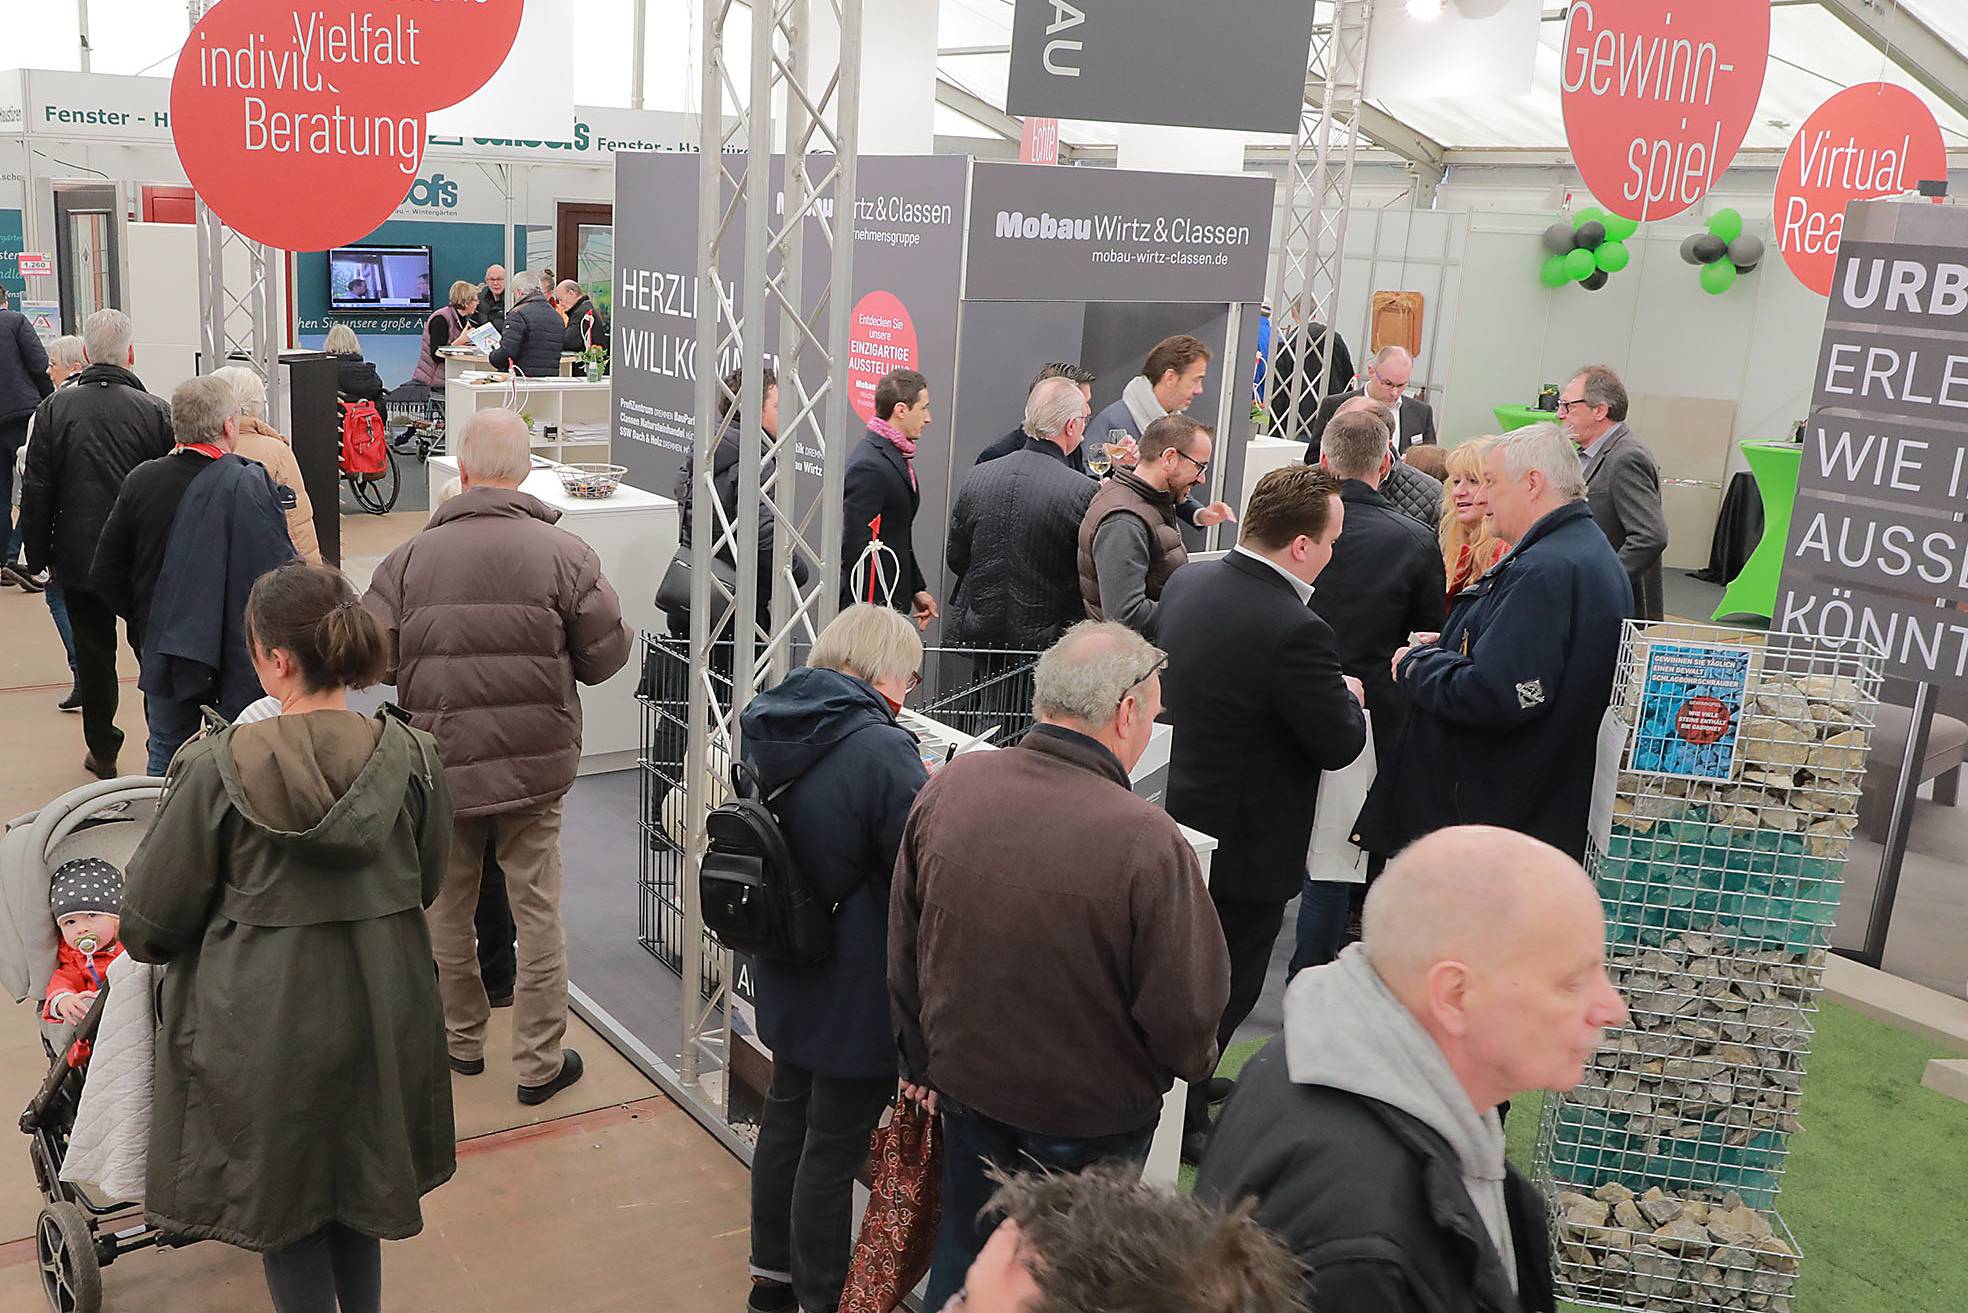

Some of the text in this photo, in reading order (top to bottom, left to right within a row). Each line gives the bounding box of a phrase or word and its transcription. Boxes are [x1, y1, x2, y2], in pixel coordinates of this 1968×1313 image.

[293, 11, 420, 66] Vielfalt
[1562, 0, 1734, 105] Gewinn-
[45, 106, 130, 125] Fenster
[245, 97, 418, 174] Beratung
[1623, 117, 1721, 222] spiel
[1800, 129, 1911, 191] Virtual
[889, 197, 951, 225] Classen
[1171, 218, 1249, 245] Classen
[1091, 250, 1228, 265] mobau-wirtz-classen.de
[381, 318, 411, 332] große
[859, 313, 904, 330] Entdecken Sie
[869, 330, 891, 341] unsere
[851, 340, 909, 362] EINZIGARTIGE
[620, 397, 654, 415] ProfiZentrum
[620, 412, 640, 426] Classen
[640, 416, 685, 438] Natursteinhandel
[619, 426, 632, 438] SSW
[632, 429, 645, 442] Dach
[650, 434, 662, 447] Holz
[804, 461, 823, 477] Wirtz
[1818, 428, 1929, 492] WIE
[1654, 655, 1693, 666] GEWINNEN
[1706, 658, 1736, 668] TÄGLICH
[1675, 667, 1704, 675] DEWALT
